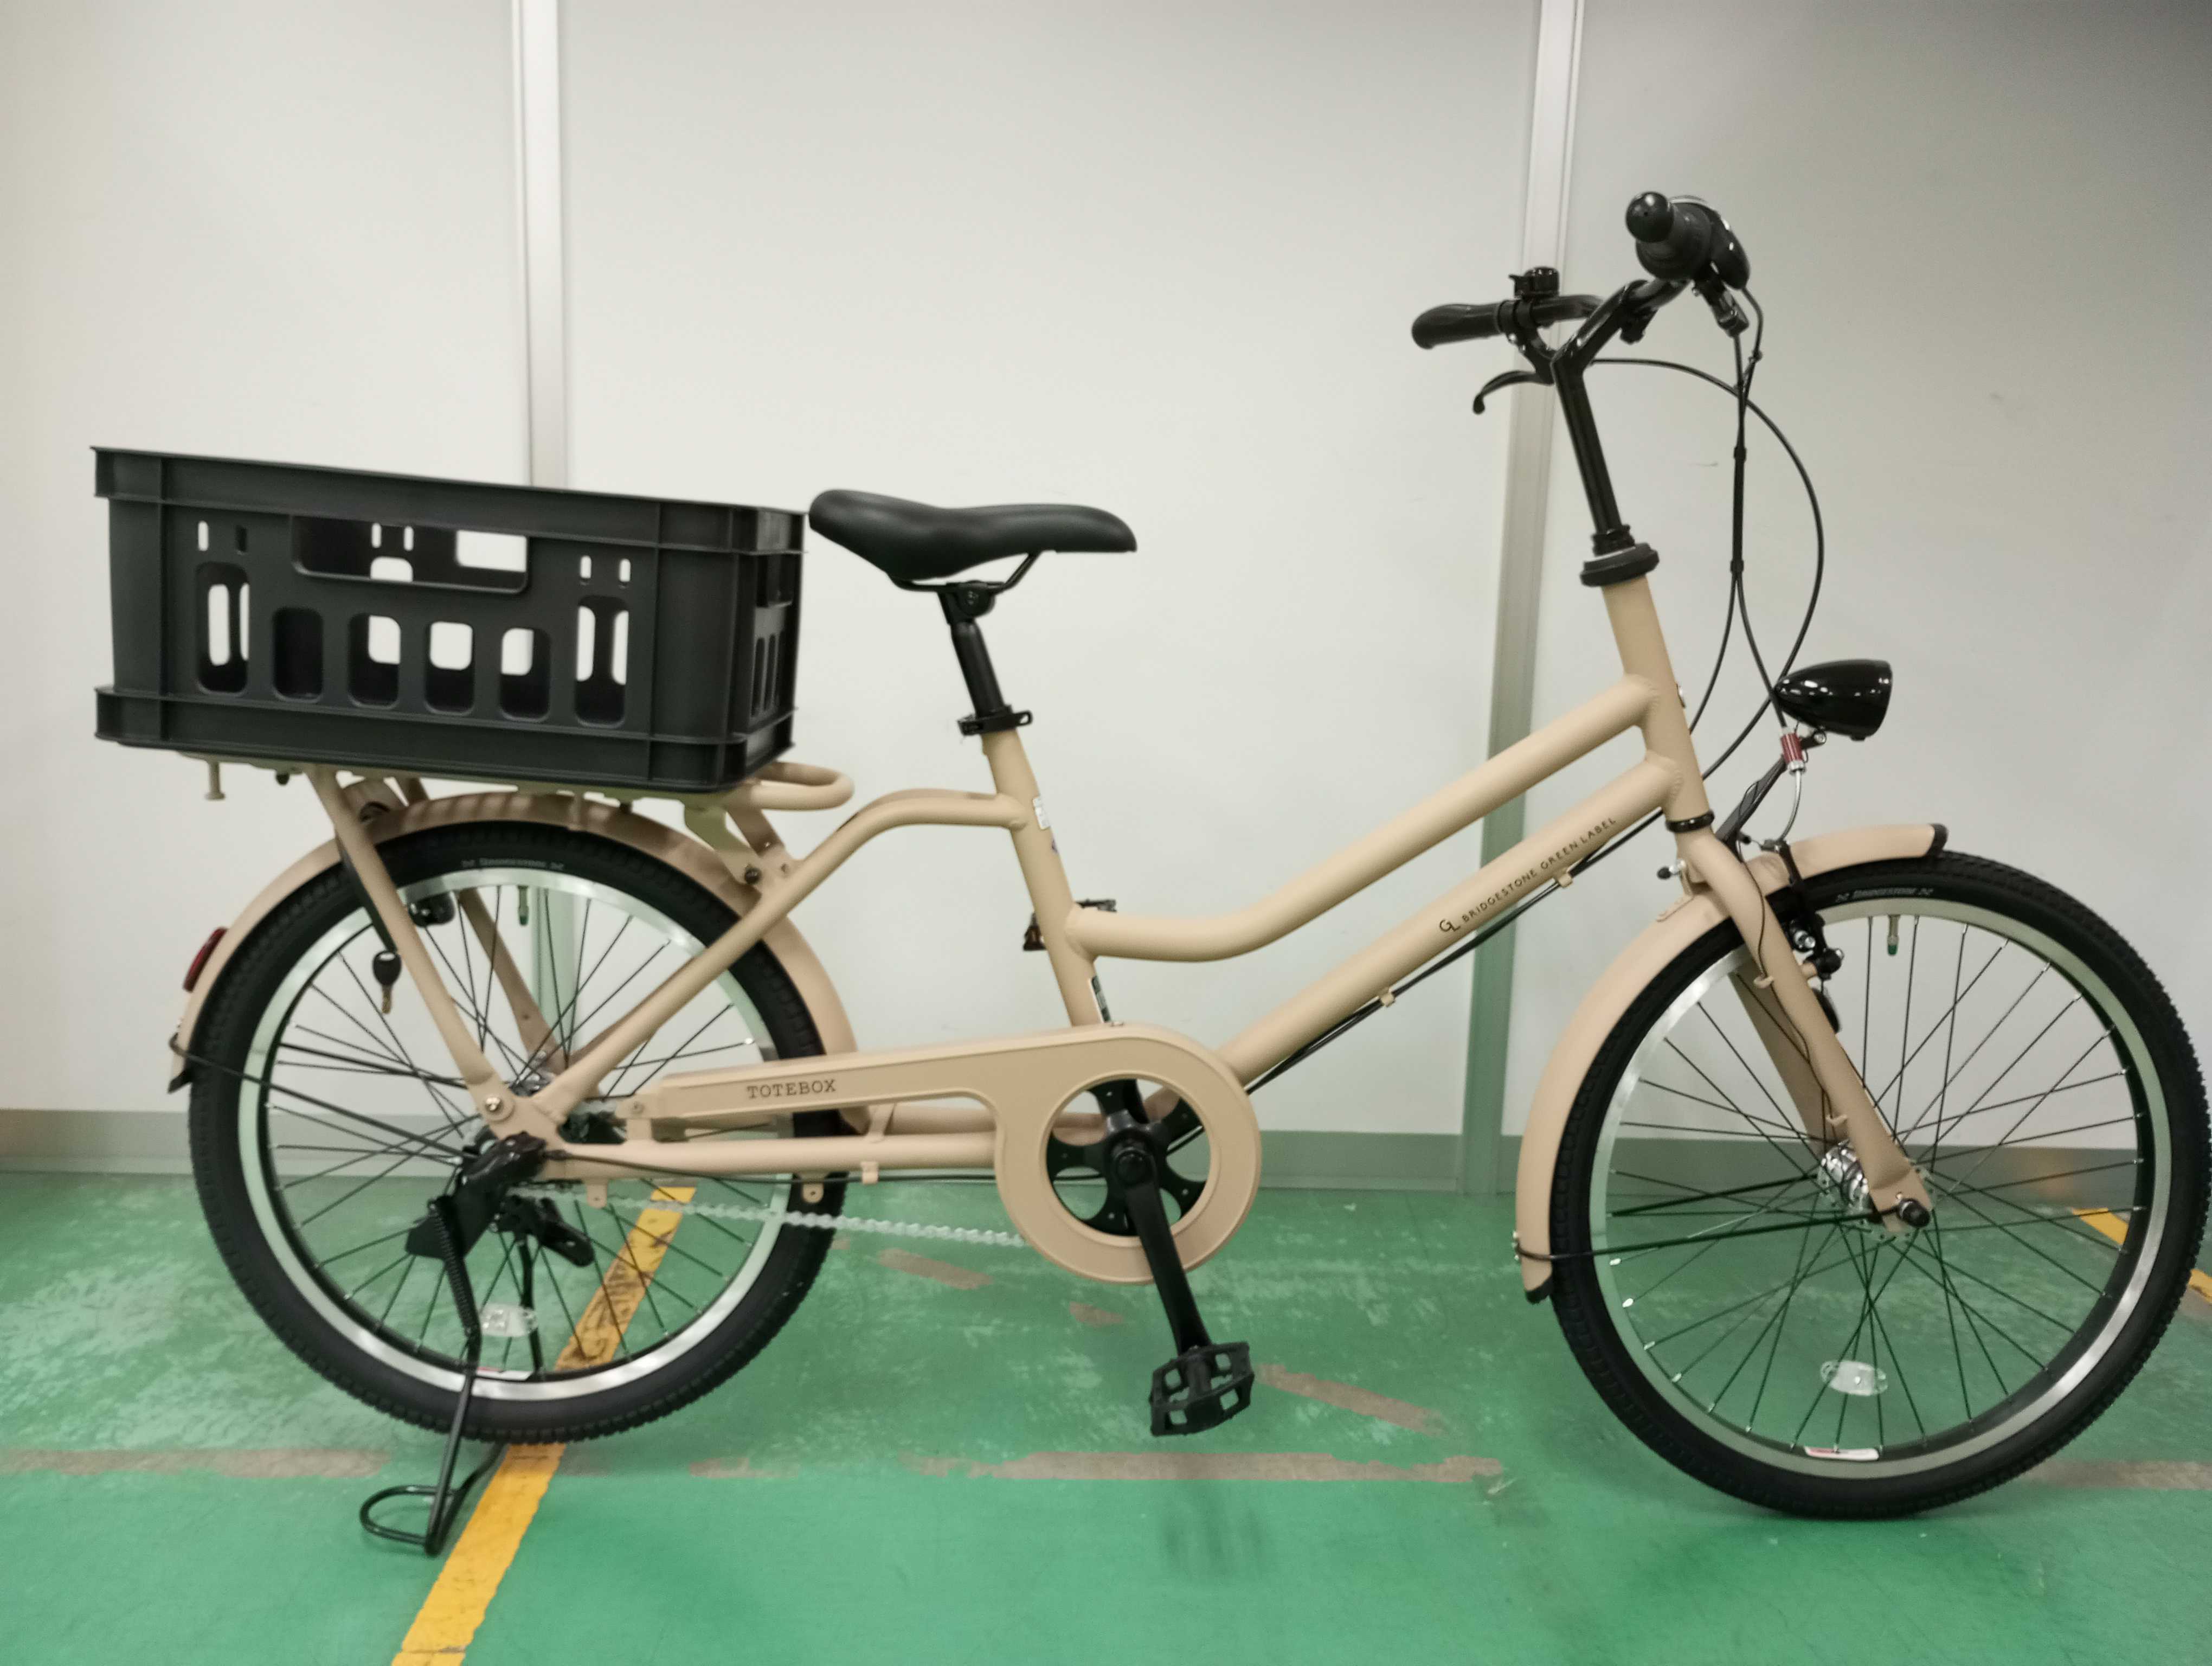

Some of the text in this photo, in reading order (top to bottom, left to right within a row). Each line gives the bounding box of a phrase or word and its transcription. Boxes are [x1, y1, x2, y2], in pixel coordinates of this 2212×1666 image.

[1462, 869, 1537, 922] BRIDGESTONE
[1540, 841, 1578, 869] GREEN
[1580, 818, 1616, 843] LABEL
[747, 1079, 837, 1099] TOTEBOX
